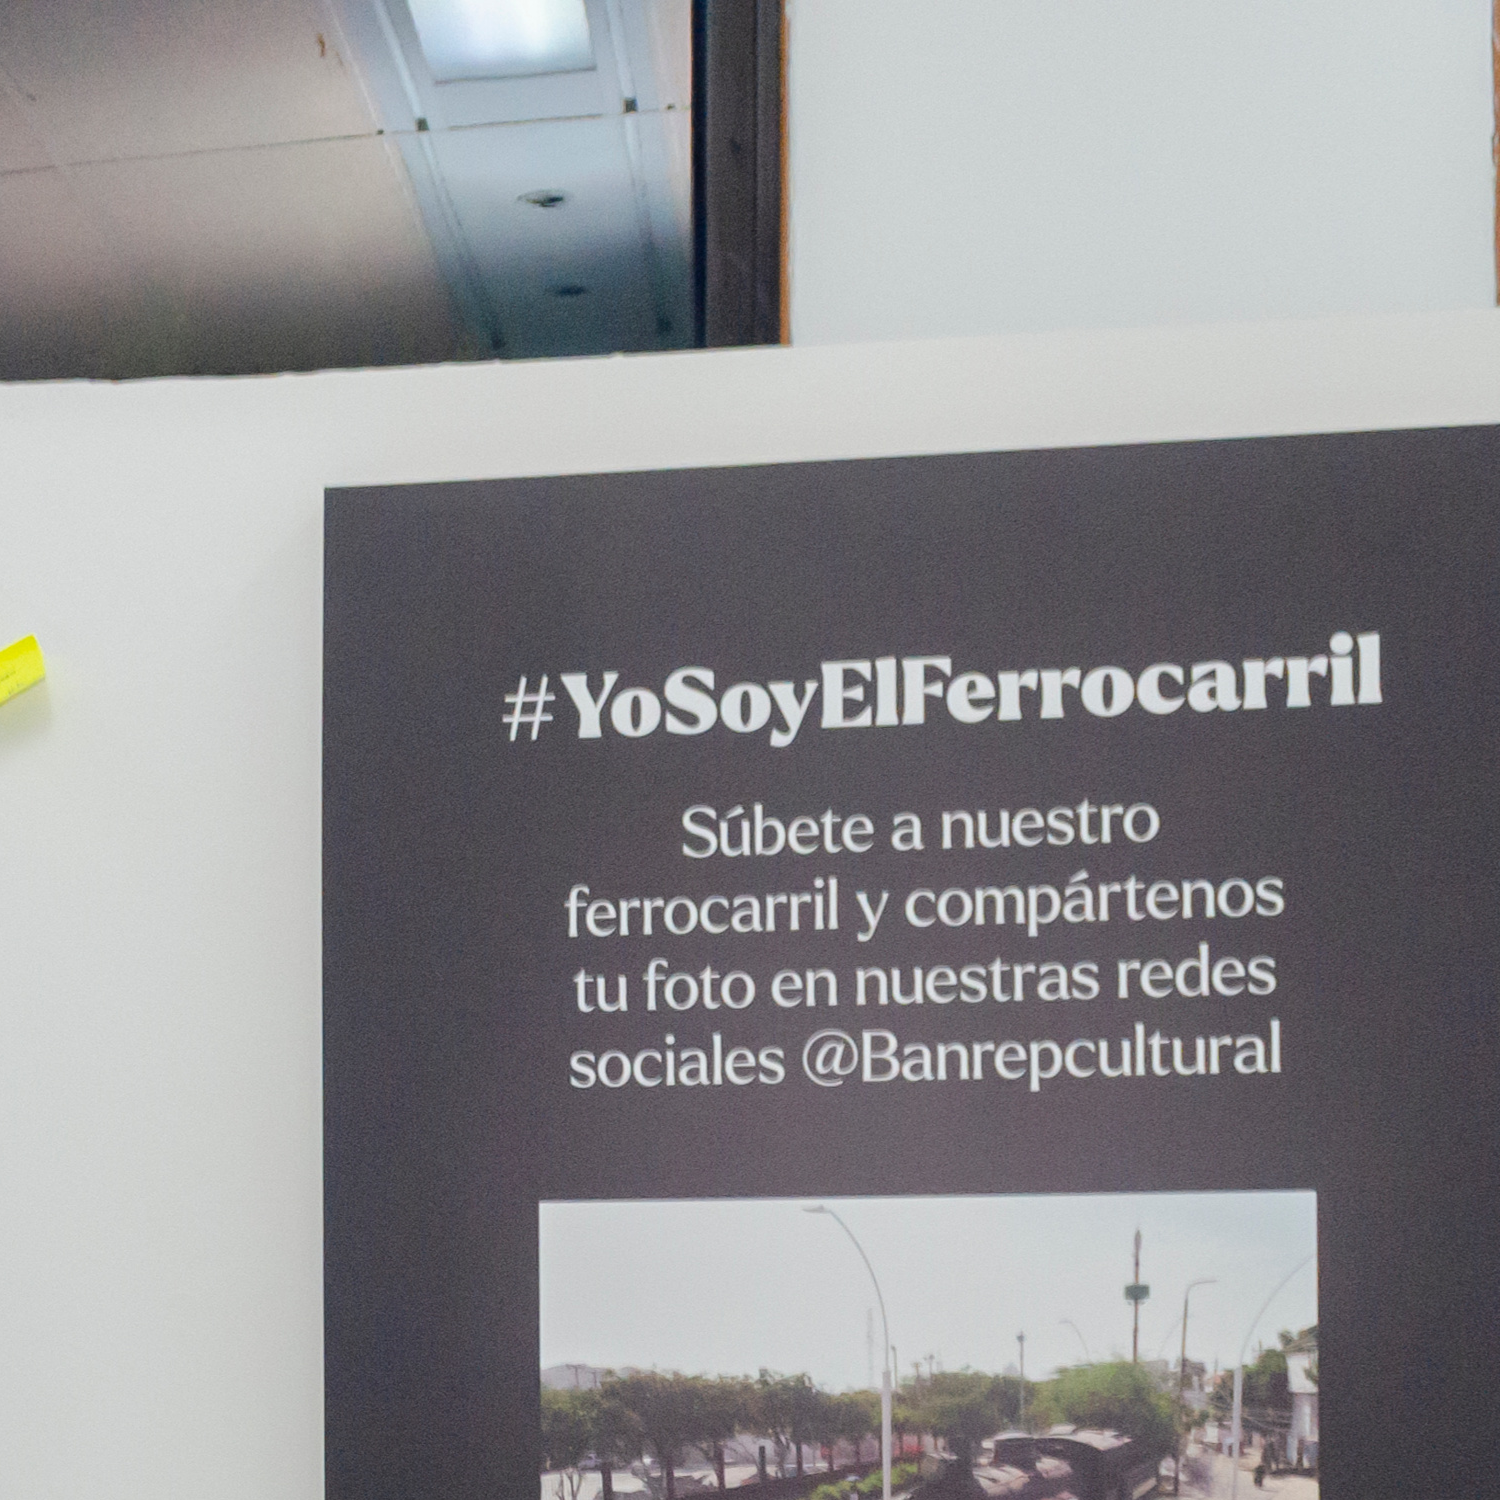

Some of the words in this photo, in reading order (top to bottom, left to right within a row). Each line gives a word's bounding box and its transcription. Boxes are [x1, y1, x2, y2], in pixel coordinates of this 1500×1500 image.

[502, 631, 1383, 748] #YoSoyElFerrocarril
[682, 802, 875, 859] Súbete
[891, 812, 924, 852] a
[941, 800, 1160, 850] nuestro
[564, 876, 839, 938] ferrocarril
[856, 891, 889, 943] y
[904, 869, 1285, 938] compártenos
[574, 969, 628, 1013] tu
[643, 958, 756, 1011] foto
[770, 968, 838, 1008] en
[855, 957, 1100, 1006] nuestras
[1117, 941, 1277, 999] redes
[570, 1032, 786, 1089] sociales
[802, 1018, 1281, 1093] @Banrepcultural
